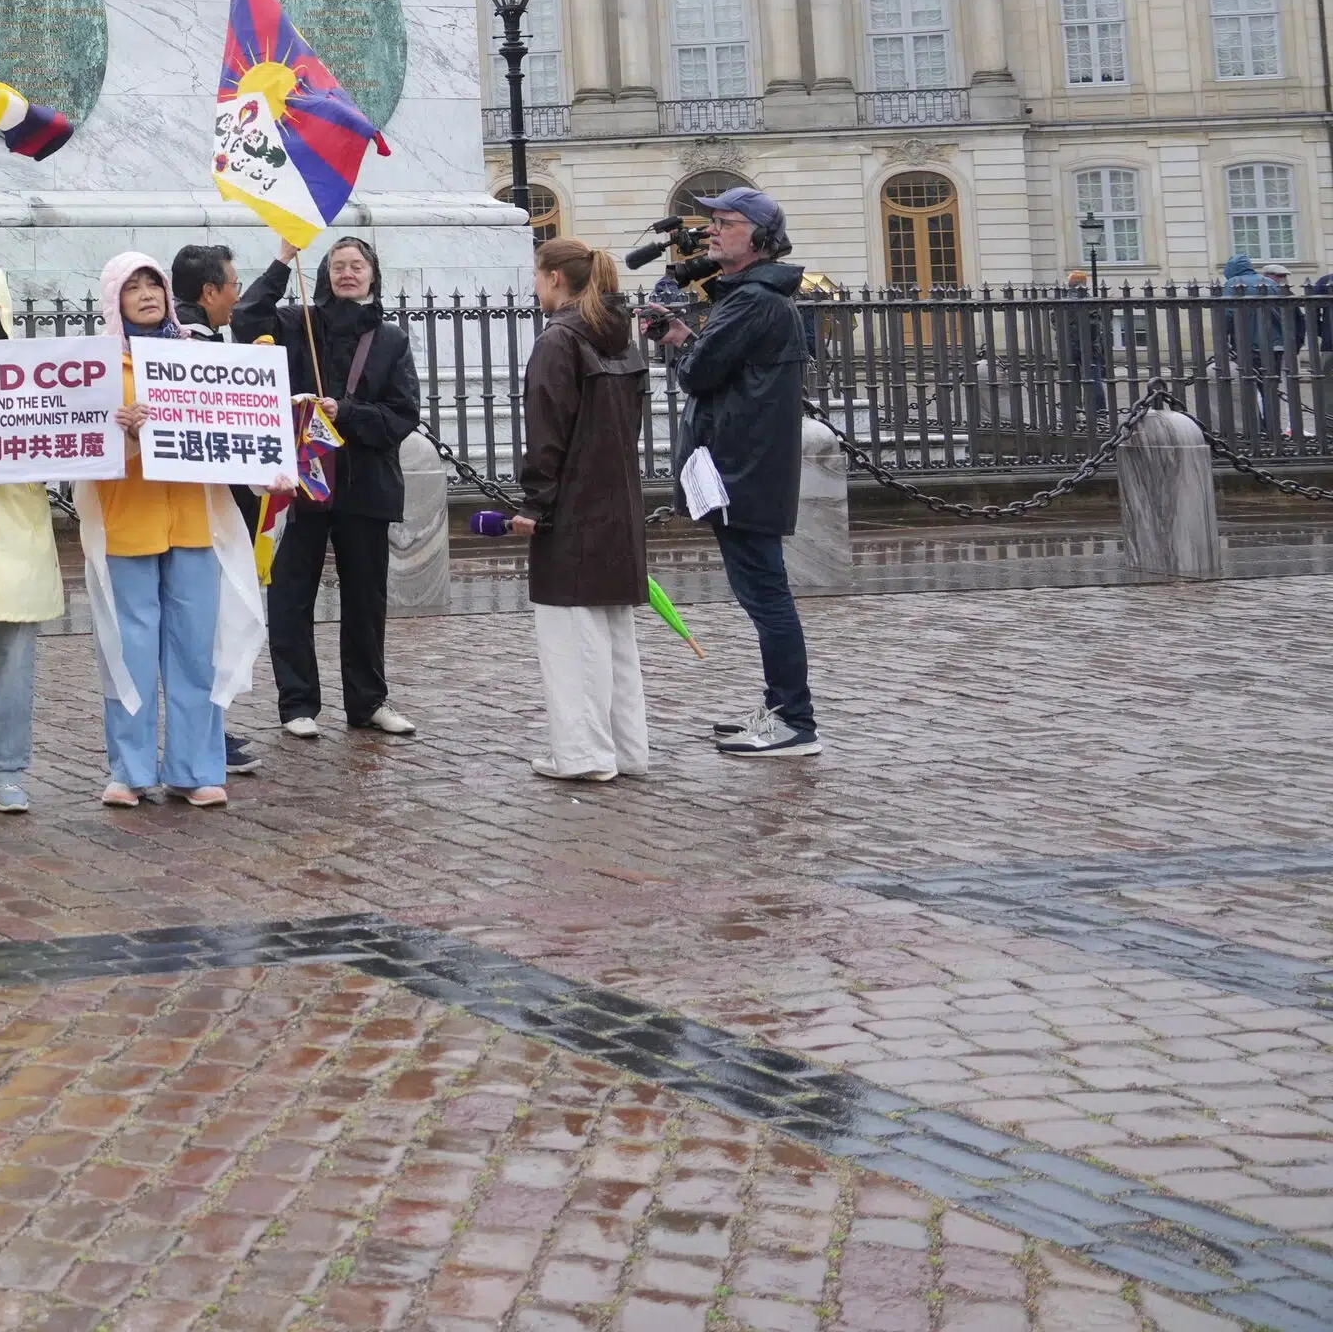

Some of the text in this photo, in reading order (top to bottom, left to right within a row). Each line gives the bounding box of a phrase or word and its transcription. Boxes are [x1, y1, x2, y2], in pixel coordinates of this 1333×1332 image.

[33, 360, 107, 389] CCP
[145, 361, 276, 387] END CCP.COM
[17, 396, 39, 409] THE
[41, 395, 66, 408] EVIL
[148, 388, 279, 409] PROTECT OUR FREEDOM
[4, 411, 68, 428] COMMUNIST
[71, 410, 109, 424] PARTY
[148, 407, 281, 427] SIGN THE PETITION
[153, 429, 283, 466] 三退保平安
